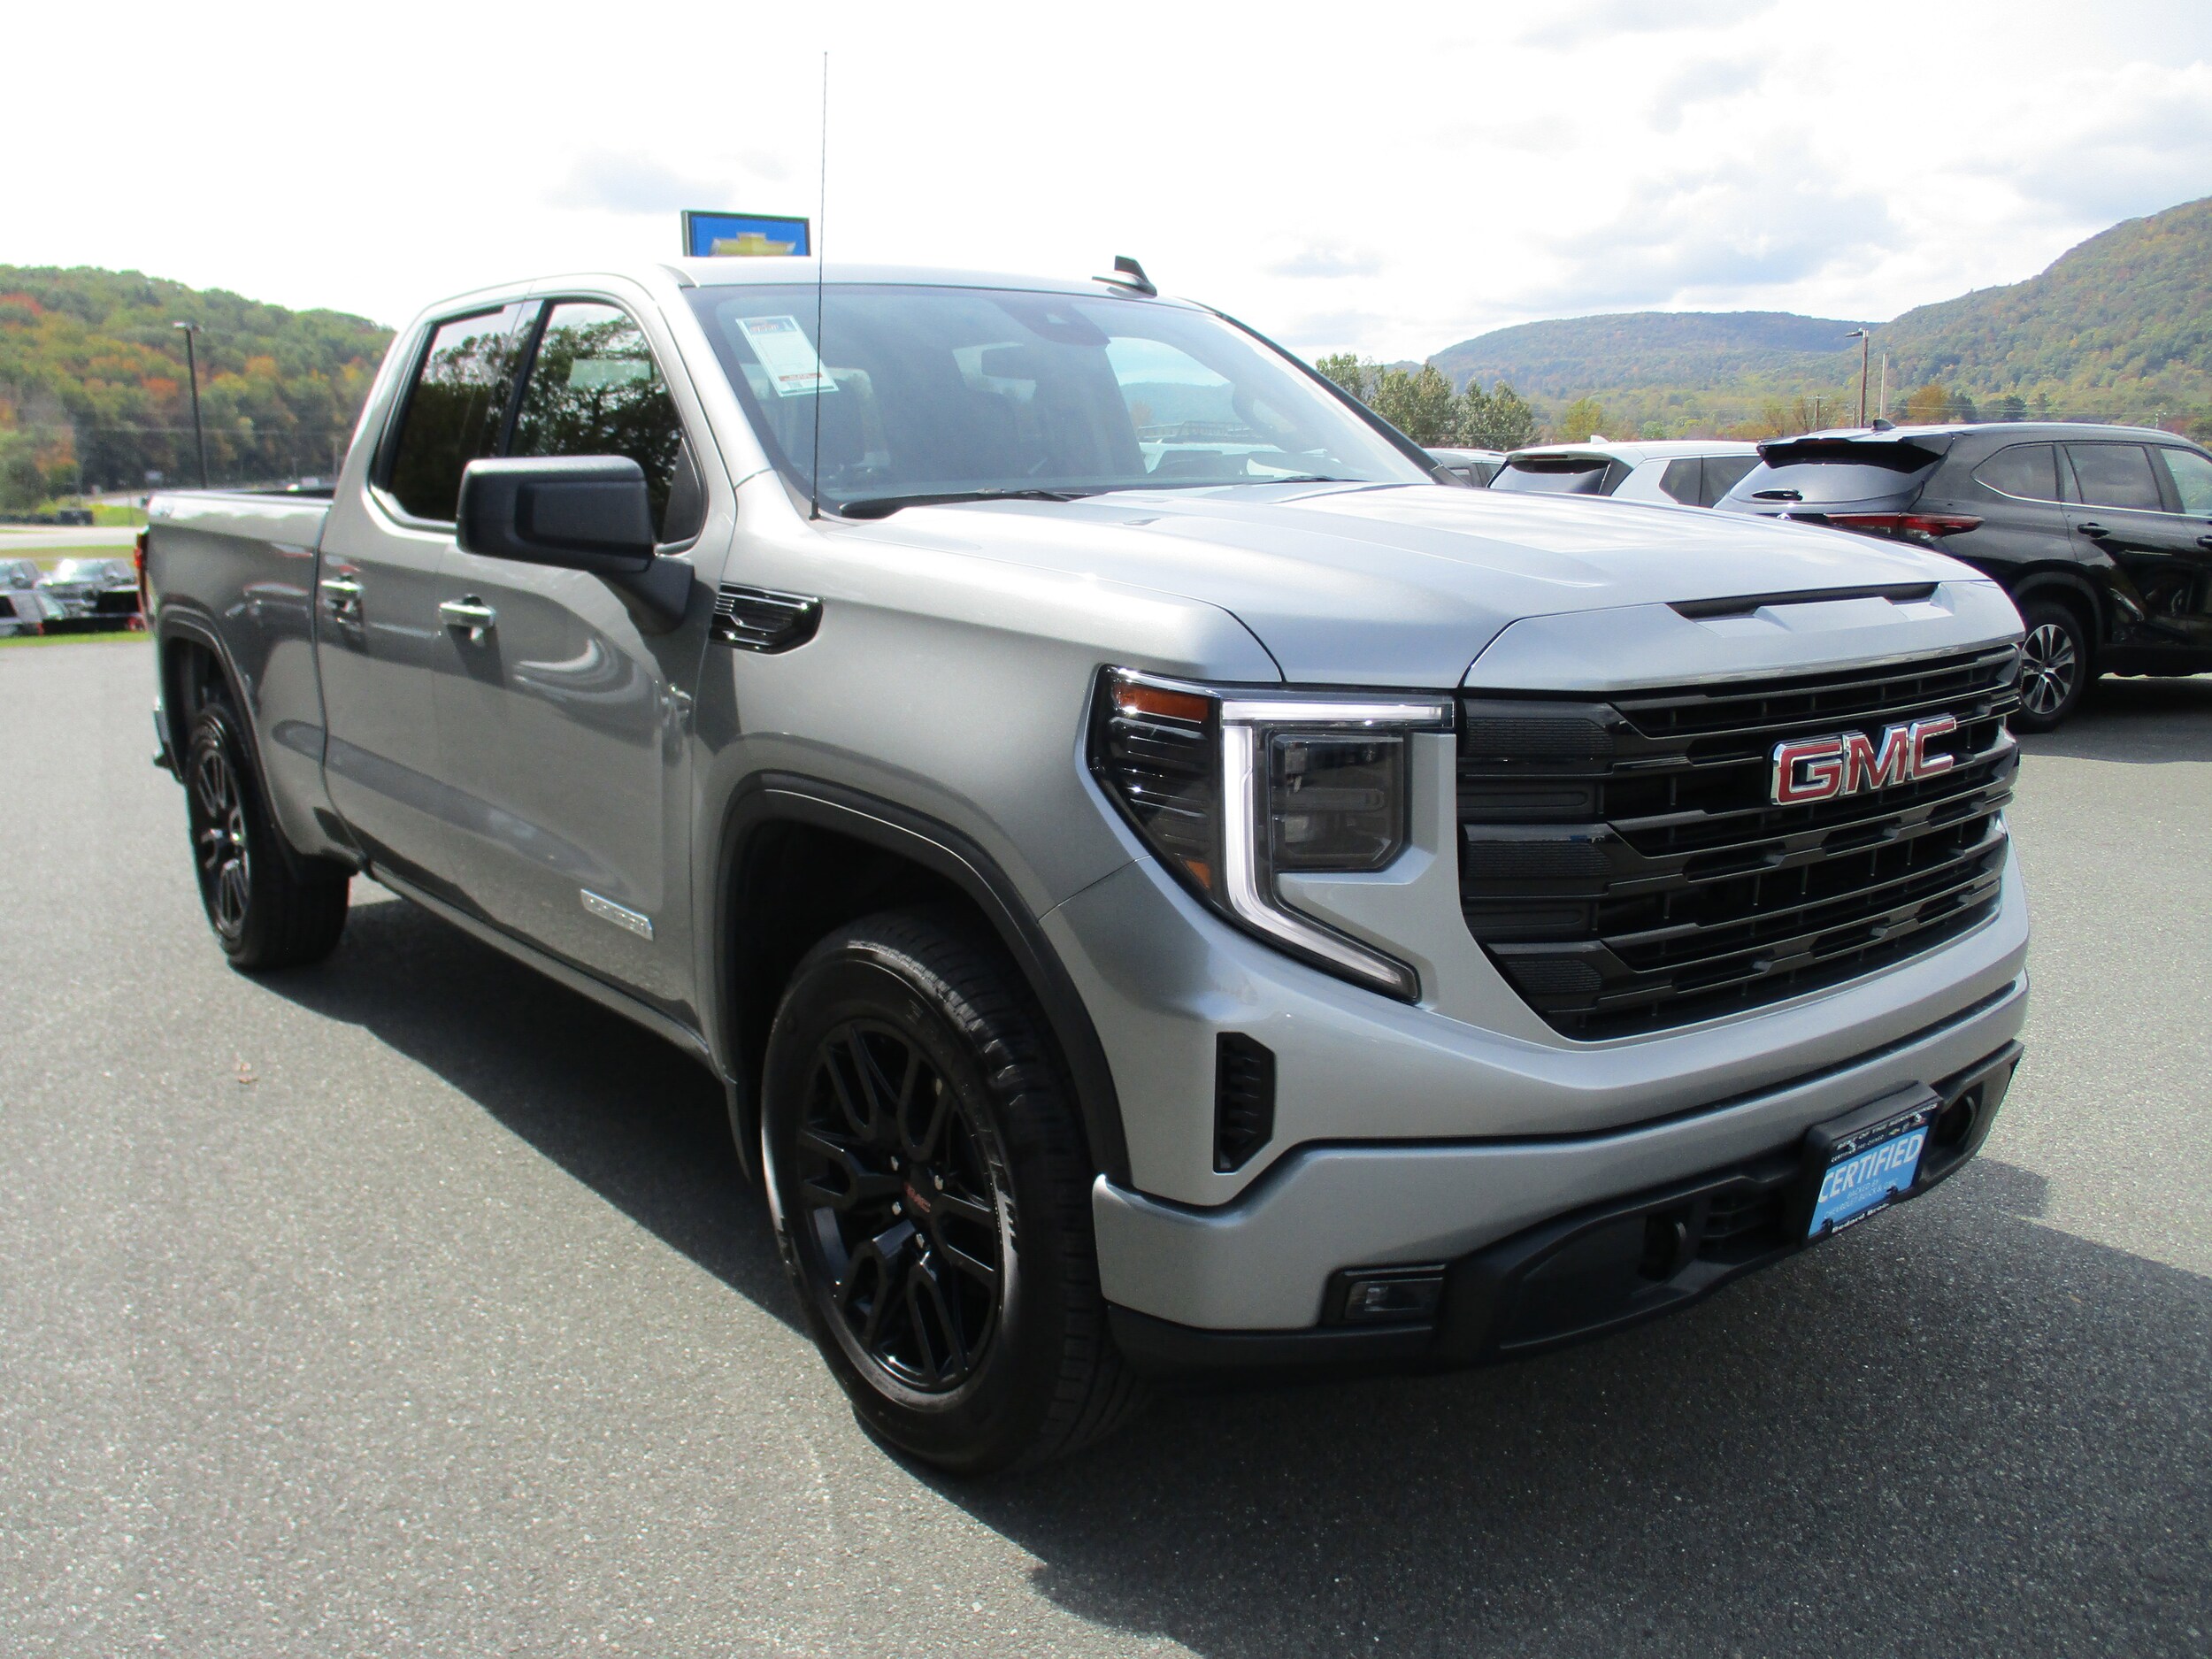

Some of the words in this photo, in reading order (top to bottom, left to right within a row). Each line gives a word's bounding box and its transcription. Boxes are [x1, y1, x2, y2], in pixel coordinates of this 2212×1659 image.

[1770, 712, 1957, 805] GMC
[1818, 1133, 1924, 1203] CERTIFIED
[1832, 1148, 1855, 1163] CERTIFIE
